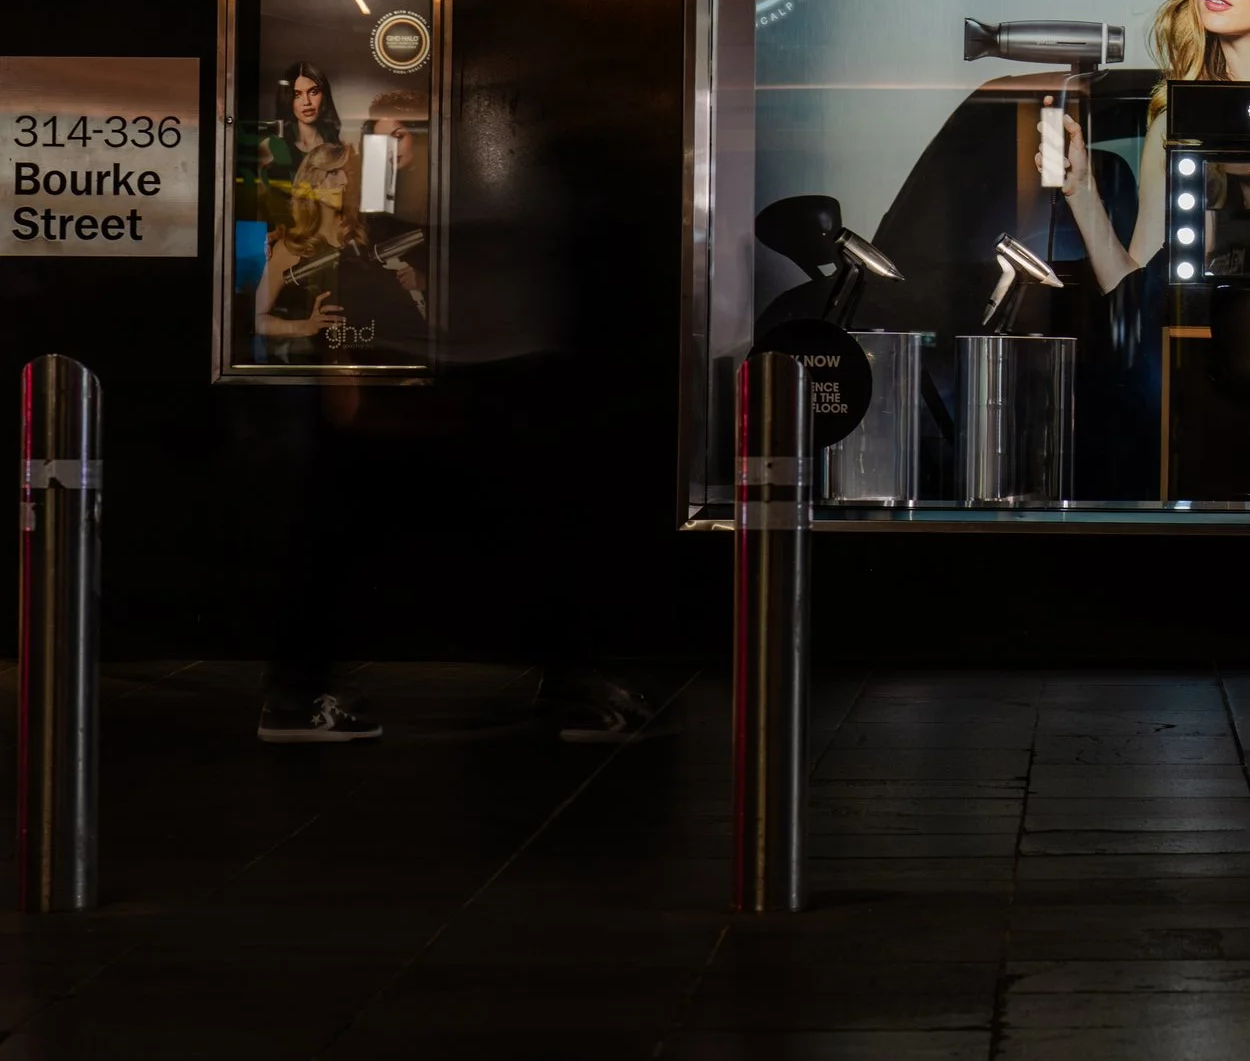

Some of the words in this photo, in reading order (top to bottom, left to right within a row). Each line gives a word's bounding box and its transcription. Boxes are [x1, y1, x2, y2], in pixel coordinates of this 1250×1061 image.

[756, 1, 793, 26] CALP
[13, 115, 182, 148] 314-336
[14, 162, 162, 195] Bourke
[11, 206, 144, 241] Street
[325, 316, 376, 350] ghd
[803, 354, 842, 368] NOW
[819, 392, 841, 403] THE
